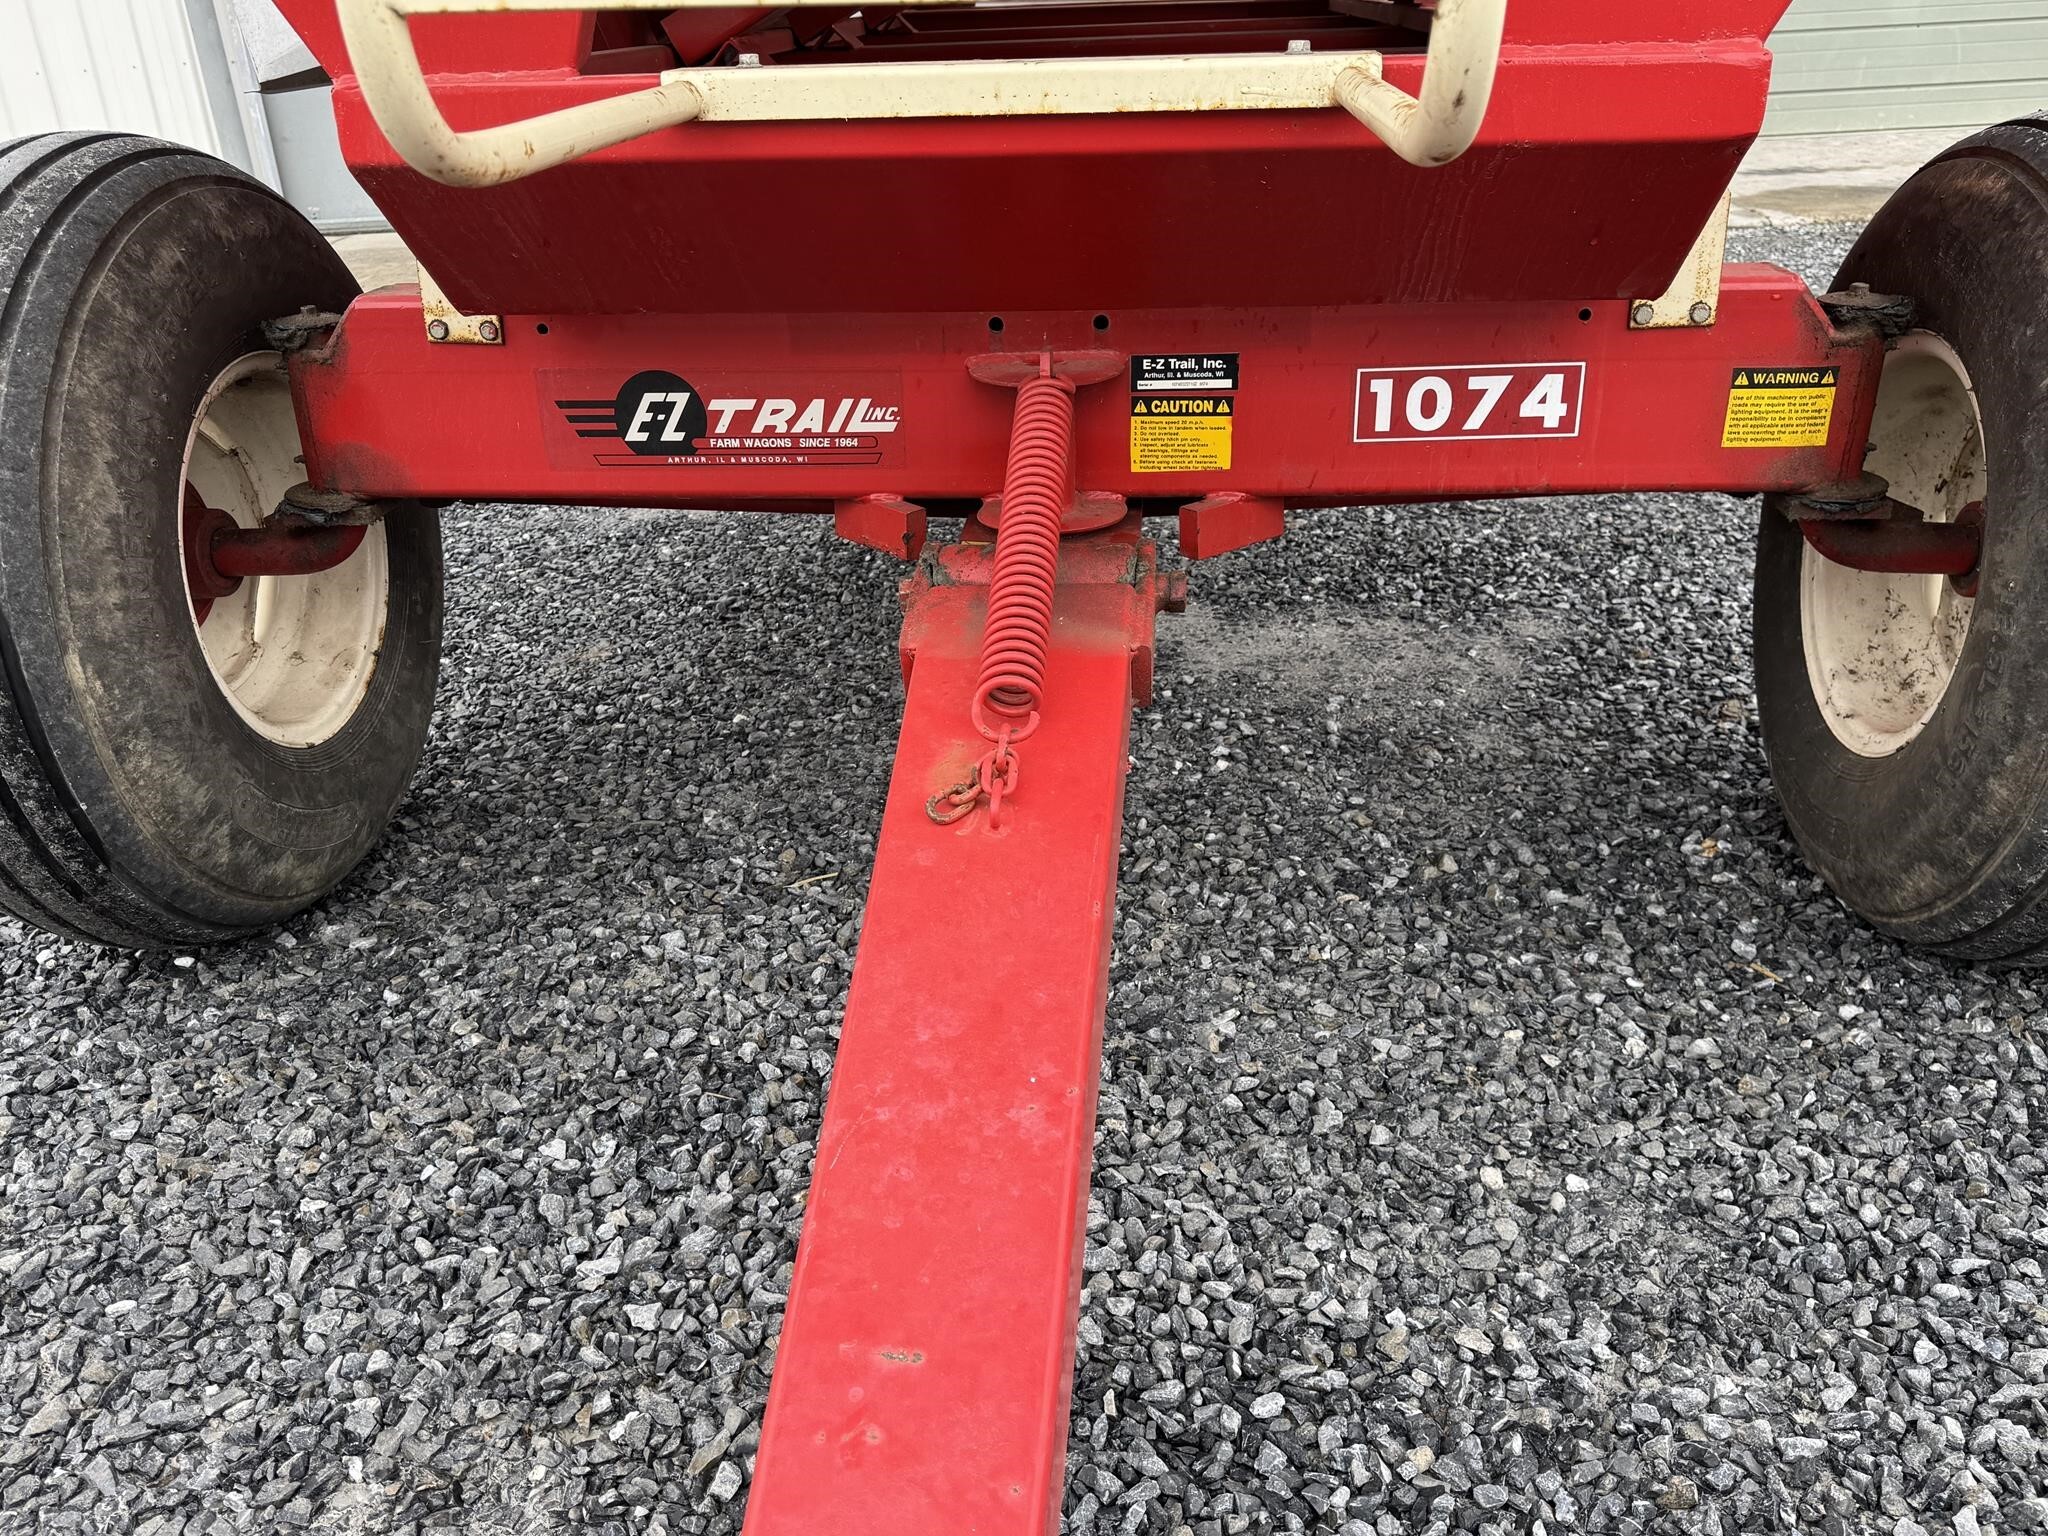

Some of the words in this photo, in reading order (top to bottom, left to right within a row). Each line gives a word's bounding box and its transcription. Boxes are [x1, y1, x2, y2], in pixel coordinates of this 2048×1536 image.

[1143, 359, 1165, 370] E-Z
[1168, 358, 1199, 371] Trail,
[1203, 358, 1227, 369] Inc.
[1753, 372, 1820, 384] WARNING
[1150, 400, 1214, 413] CAUTION
[1369, 373, 1568, 433] 1074
[624, 392, 691, 442] E-Z
[707, 398, 899, 433] TRAIL
[865, 406, 901, 421] INC.
[709, 438, 740, 448] FARM
[742, 438, 792, 448] WAGONS
[799, 437, 832, 448] SINCE
[833, 437, 859, 448] 1964
